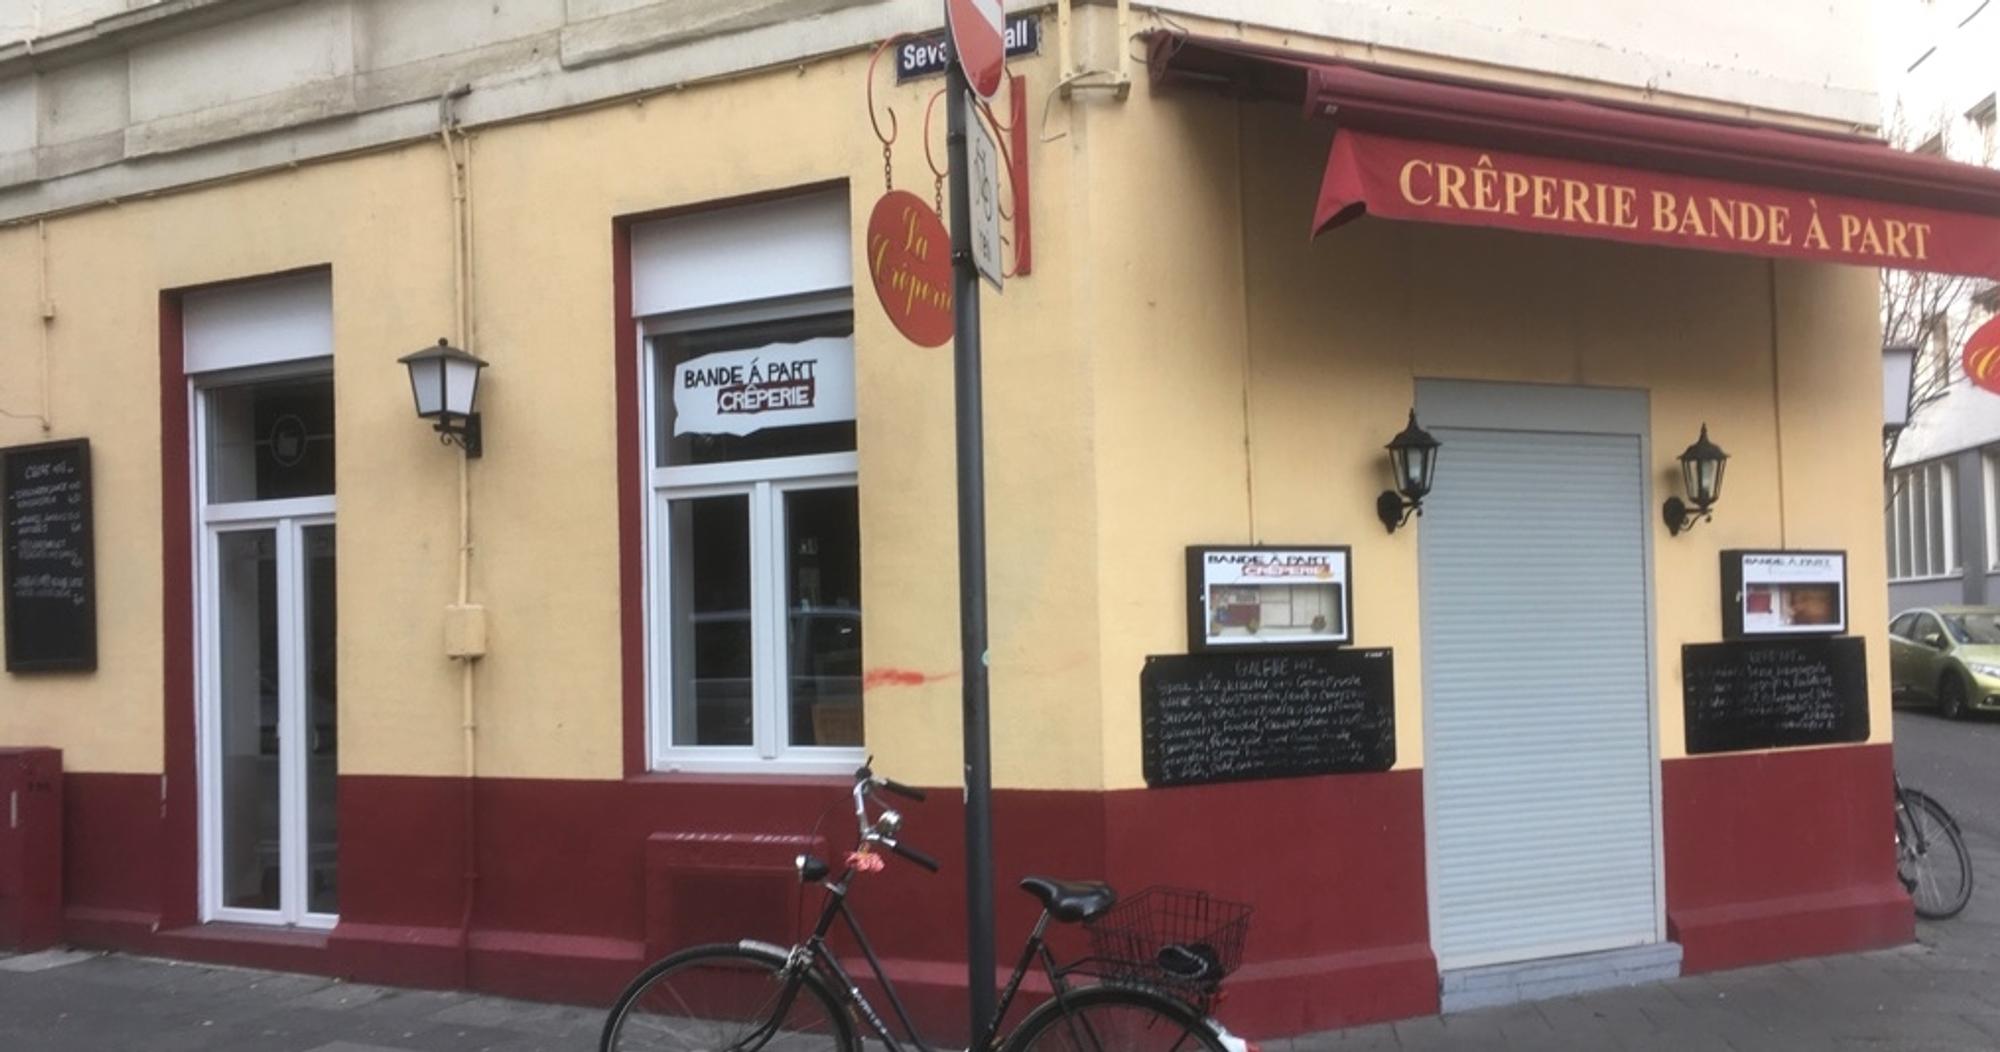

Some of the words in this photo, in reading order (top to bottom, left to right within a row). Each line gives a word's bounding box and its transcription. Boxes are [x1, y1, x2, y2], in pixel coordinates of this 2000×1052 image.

[1400, 153, 1639, 229] CRÊPERIE
[1651, 189, 1792, 246] BANDE
[1803, 198, 1832, 251] À
[1839, 213, 1931, 261] PART
[684, 365, 743, 389] BANDE
[767, 358, 818, 382] PART
[719, 383, 810, 412] CRÊPERIE
